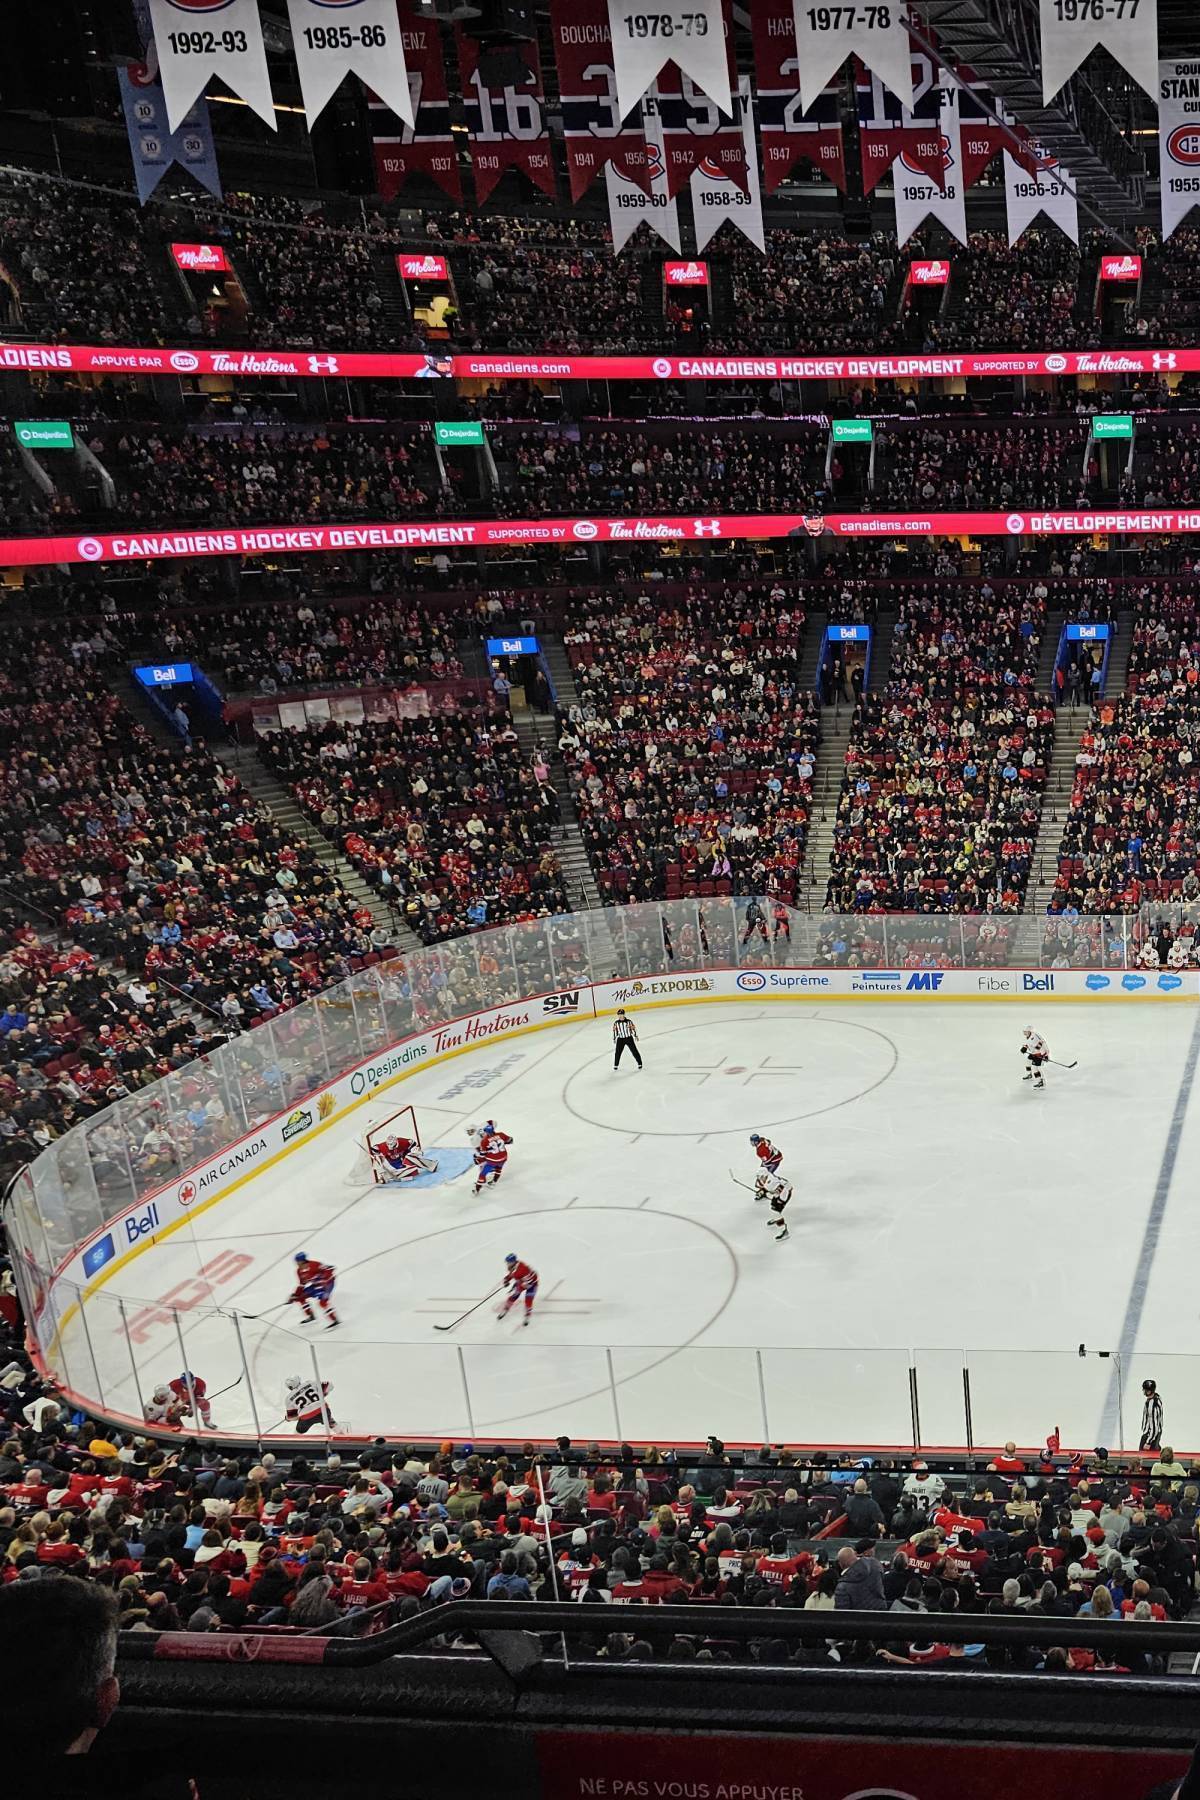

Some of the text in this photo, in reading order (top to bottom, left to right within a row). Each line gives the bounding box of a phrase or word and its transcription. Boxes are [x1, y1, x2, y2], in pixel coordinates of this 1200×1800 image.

[1054, 0, 1138, 21] 1976-77
[624, 13, 708, 37] 1978-79
[806, 6, 890, 31] 1977-78
[168, 29, 248, 54] 1992-93
[303, 24, 387, 50] 1985-86
[768, 147, 790, 160] 1947
[819, 145, 839, 159] 1961
[867, 144, 889, 157] 1951
[916, 143, 939, 157] 1963
[967, 141, 989, 154] 1952
[477, 155, 499, 169] 1940
[527, 154, 549, 168] 1954
[574, 153, 594, 166] 1941
[624, 151, 645, 165] 1956
[671, 151, 694, 164] 1942
[720, 149, 741, 163] 1960
[383, 158, 406, 172] 1923
[431, 157, 451, 171] 1937
[903, 186, 956, 200] 1957-58
[1013, 182, 1067, 197] 1956-57
[616, 193, 667, 208] 1959-60
[700, 191, 752, 206] 1958-59
[177, 249, 219, 267] Molson
[404, 259, 442, 276] Molson
[669, 266, 704, 282] Molson
[914, 265, 947, 282] Molson
[1104, 261, 1138, 276] Molson
[91, 354, 162, 367] APPUYÉ PAR
[470, 361, 571, 374] canadiens.com
[679, 359, 963, 376] CANADIENS HOCKEY DEVELOPMENT
[973, 360, 1039, 371] SUPPORTED BY
[840, 520, 931, 532] canadiens.com
[1031, 514, 1173, 532] DÉVELOPPEMENT
[488, 528, 565, 540] SUPPORTED BY
[112, 527, 475, 558] CANADIENS HOCKEY DEVELOPMENT
[840, 627, 857, 638] Bell
[1079, 627, 1096, 638] Bell
[502, 640, 523, 653] Bell
[153, 668, 176, 683] Bell
[741, 974, 829, 989] Esso Suprême
[852, 982, 902, 991] Peintures
[978, 973, 1055, 991] Fibe Bell
[543, 991, 580, 1011] SN
[432, 1011, 529, 1053] Tim Hortons
[367, 1043, 427, 1083] Desjardins
[199, 1138, 268, 1190] AIR CANADA
[125, 1202, 160, 1244] Bell
[295, 1387, 320, 1409] 26
[580, 1777, 804, 1800] NE PAS VOUS APPUYER
